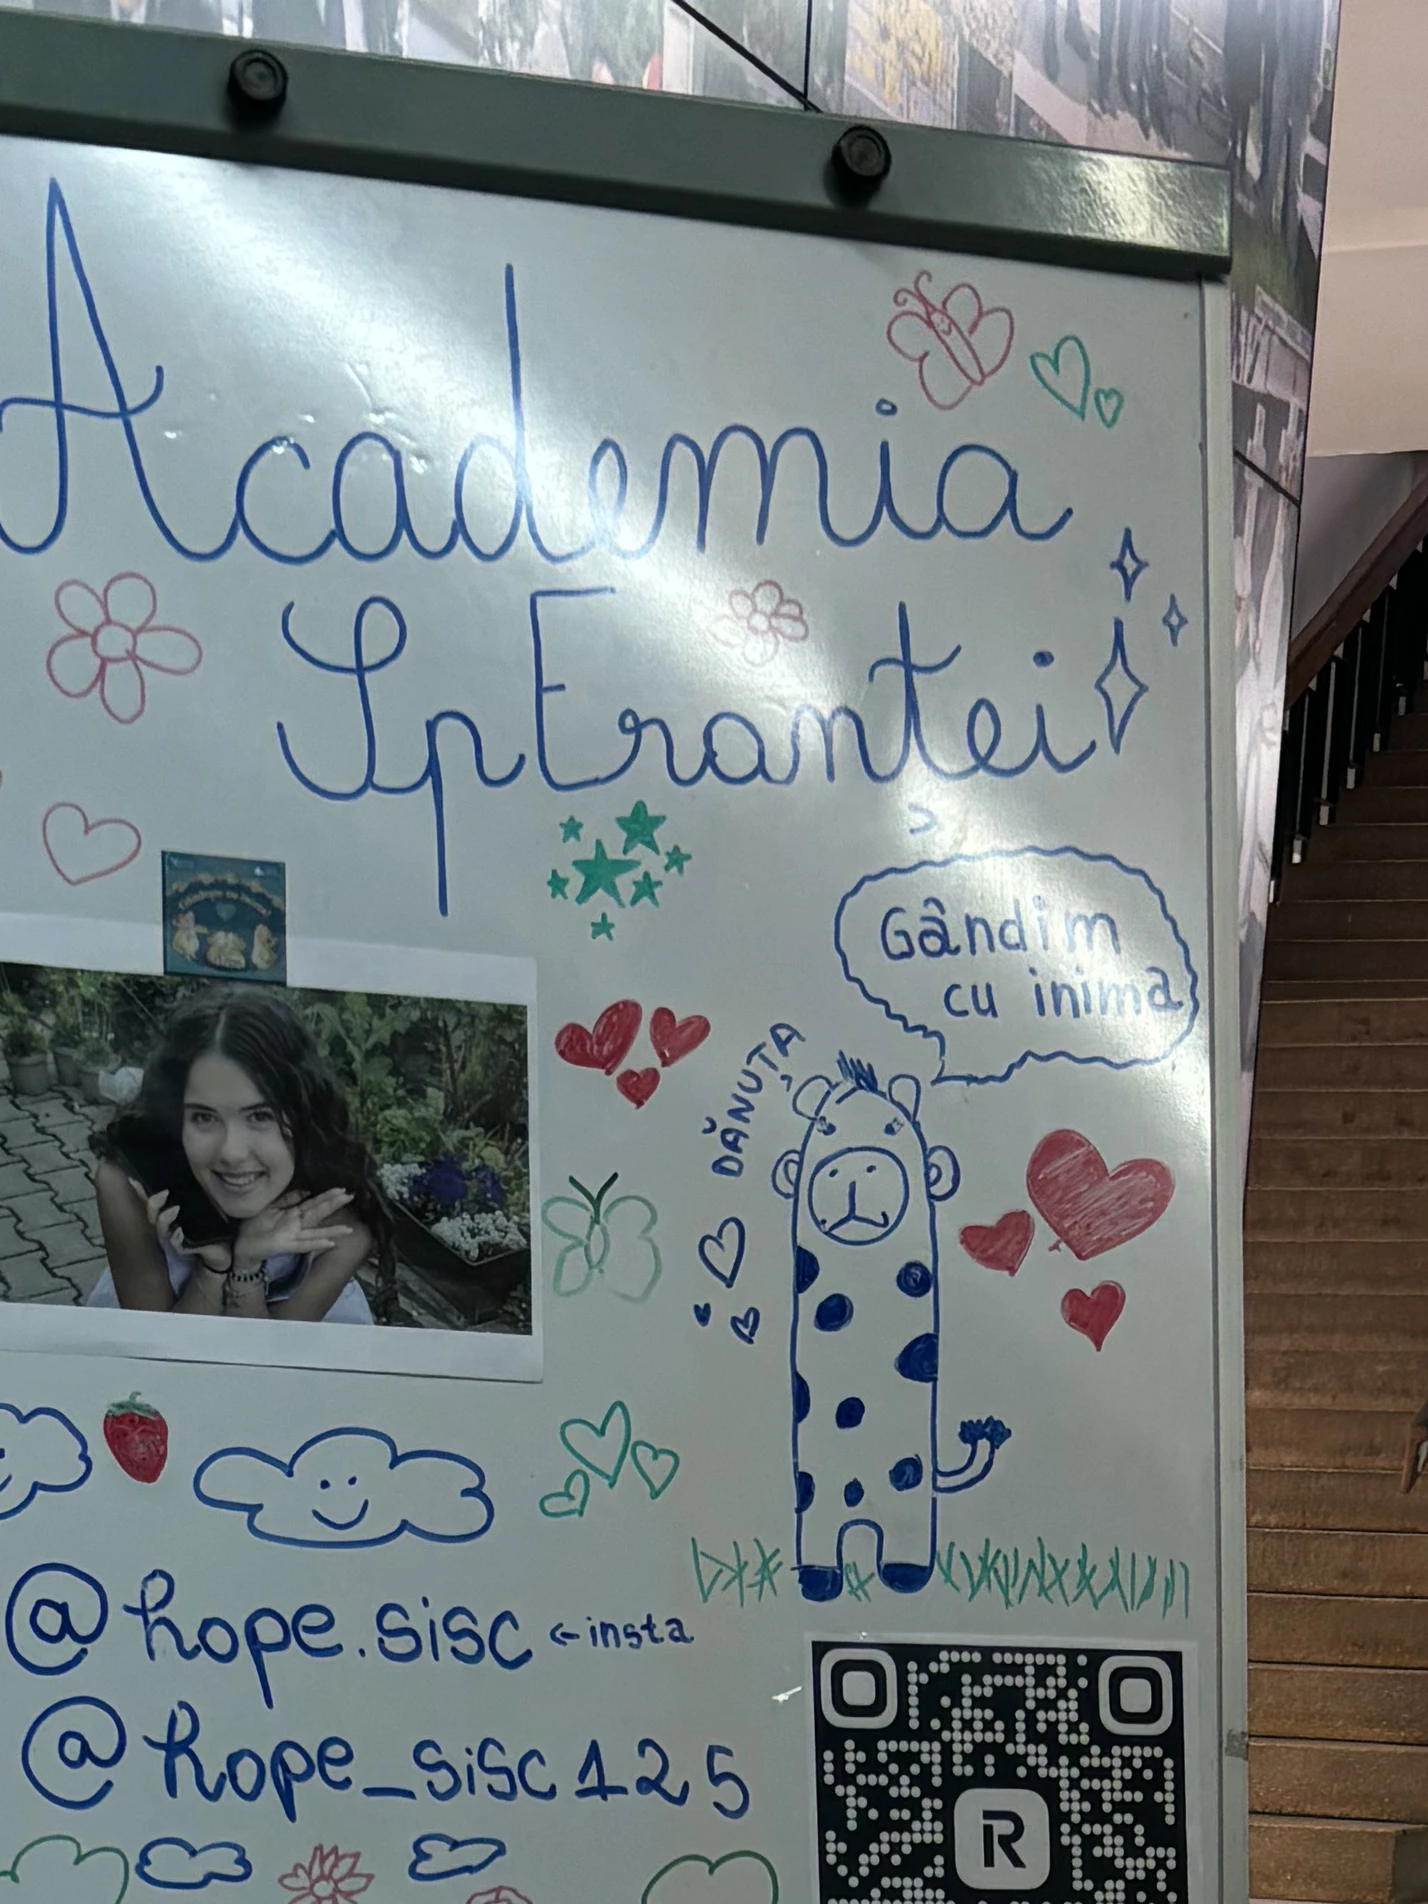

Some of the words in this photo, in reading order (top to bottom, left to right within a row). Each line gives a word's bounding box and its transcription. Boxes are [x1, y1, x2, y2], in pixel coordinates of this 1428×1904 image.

[880, 896, 1120, 961] Gândim
[944, 983, 999, 1018] cu
[589, 1615, 695, 1649] insta
